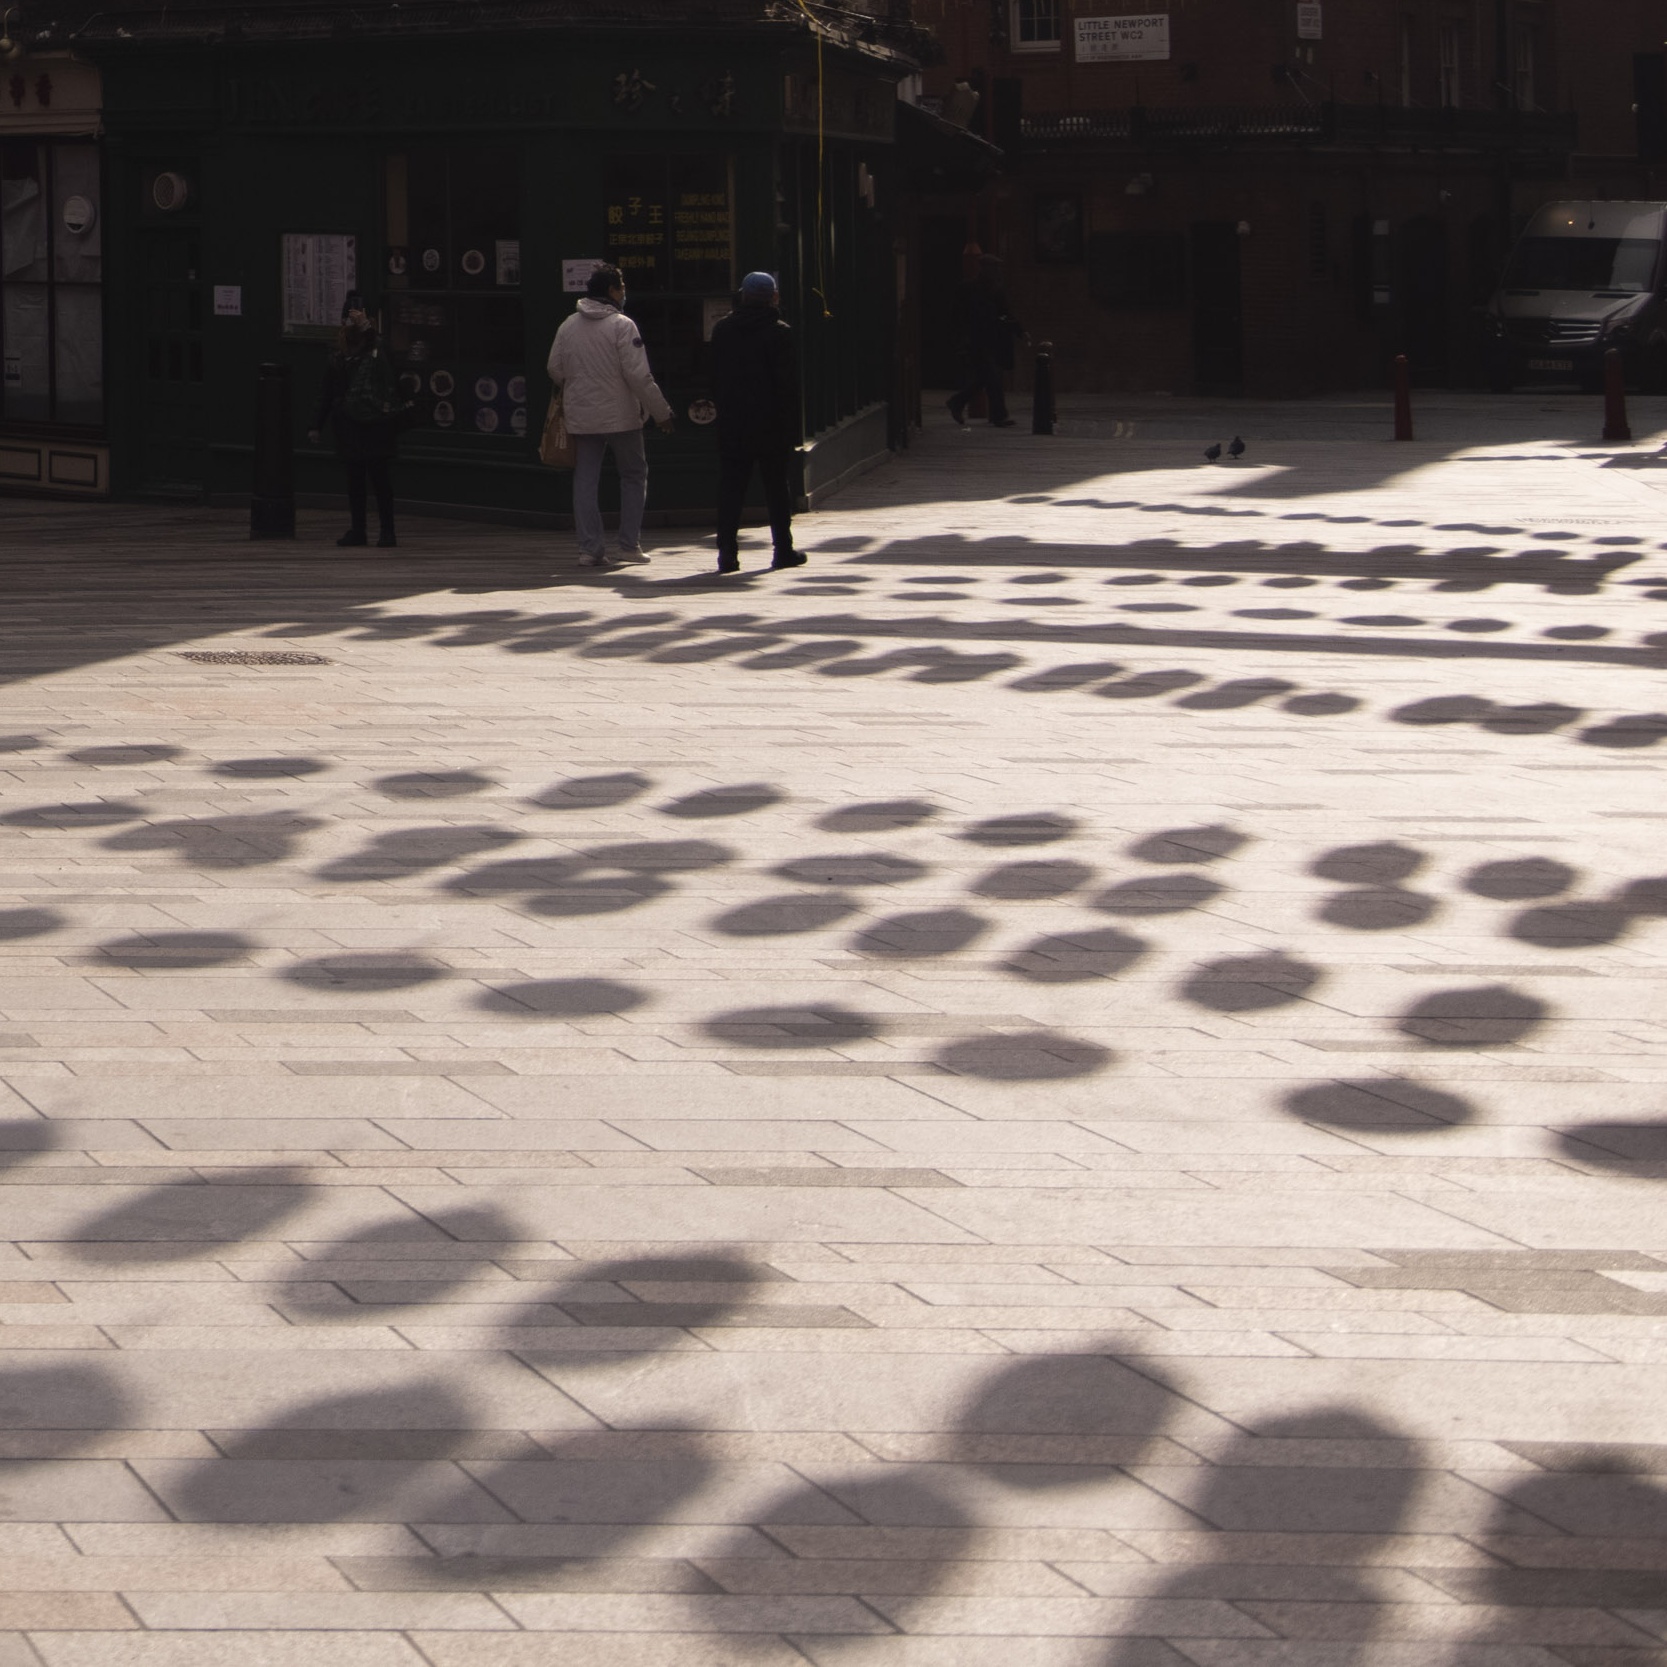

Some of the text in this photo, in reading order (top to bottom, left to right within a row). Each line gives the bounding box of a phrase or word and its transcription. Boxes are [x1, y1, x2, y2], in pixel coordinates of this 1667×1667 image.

[1078, 18, 1164, 31] LITTLE NEWPORT
[1079, 31, 1143, 42] STREET WC2
